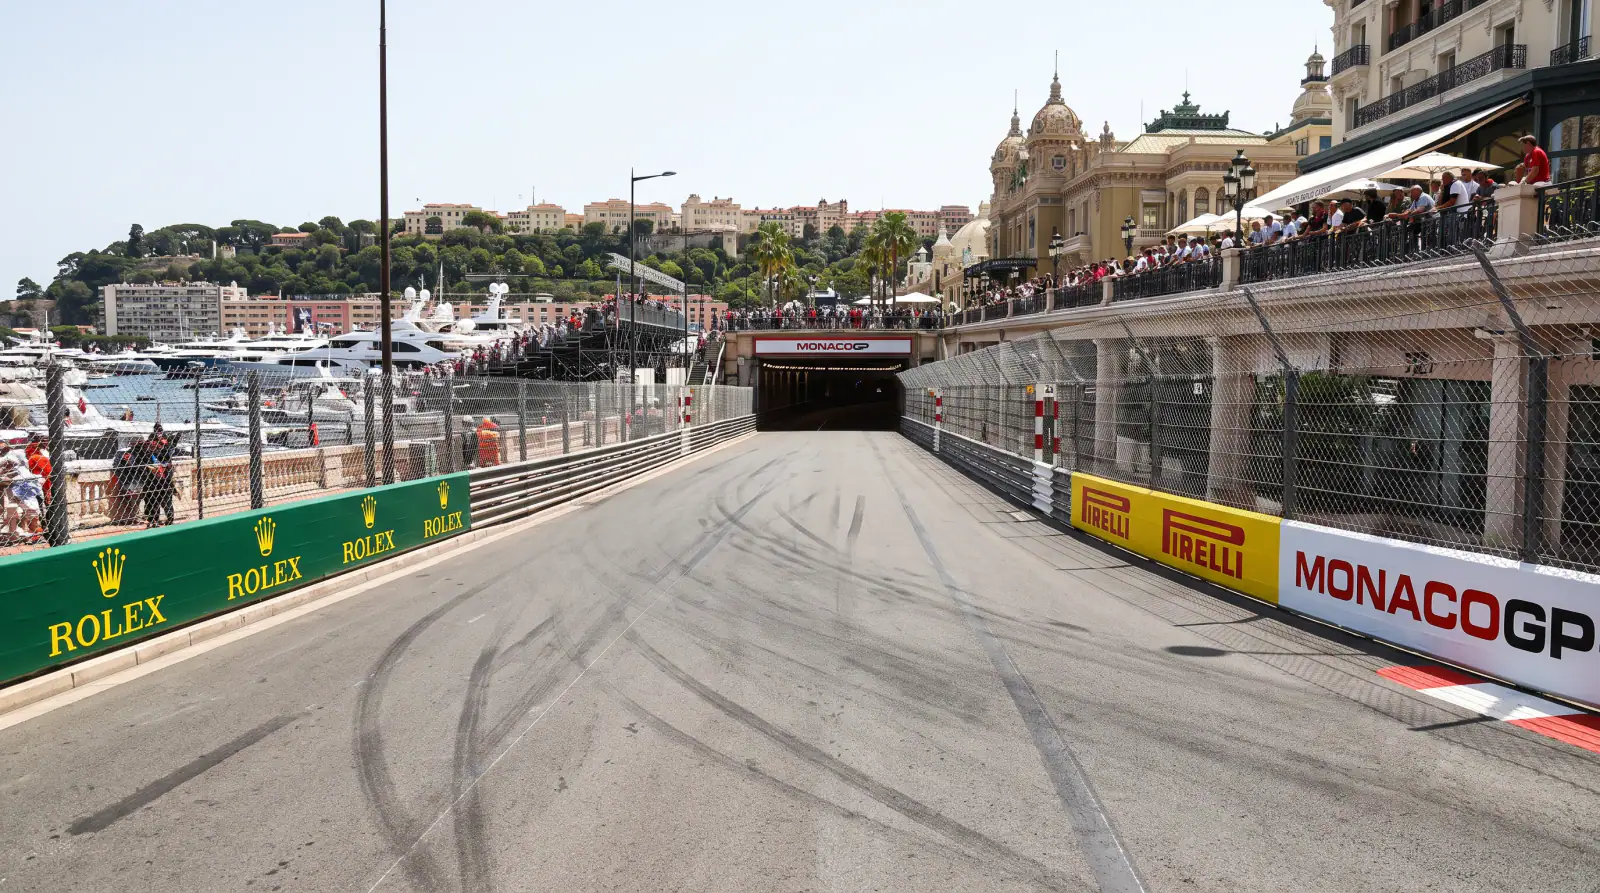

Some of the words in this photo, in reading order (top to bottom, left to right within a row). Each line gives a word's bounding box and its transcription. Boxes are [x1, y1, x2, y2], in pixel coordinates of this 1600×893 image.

[796, 342, 869, 351] MONACOGP
[424, 512, 463, 538] ROLEX
[1082, 485, 1131, 540] PIRELLI
[342, 530, 395, 564] ROLEX
[1162, 508, 1245, 580] PIRELLI
[227, 556, 302, 600] ROLEX
[48, 594, 167, 657] ROLEX
[1296, 550, 1595, 660] MONACOGP
